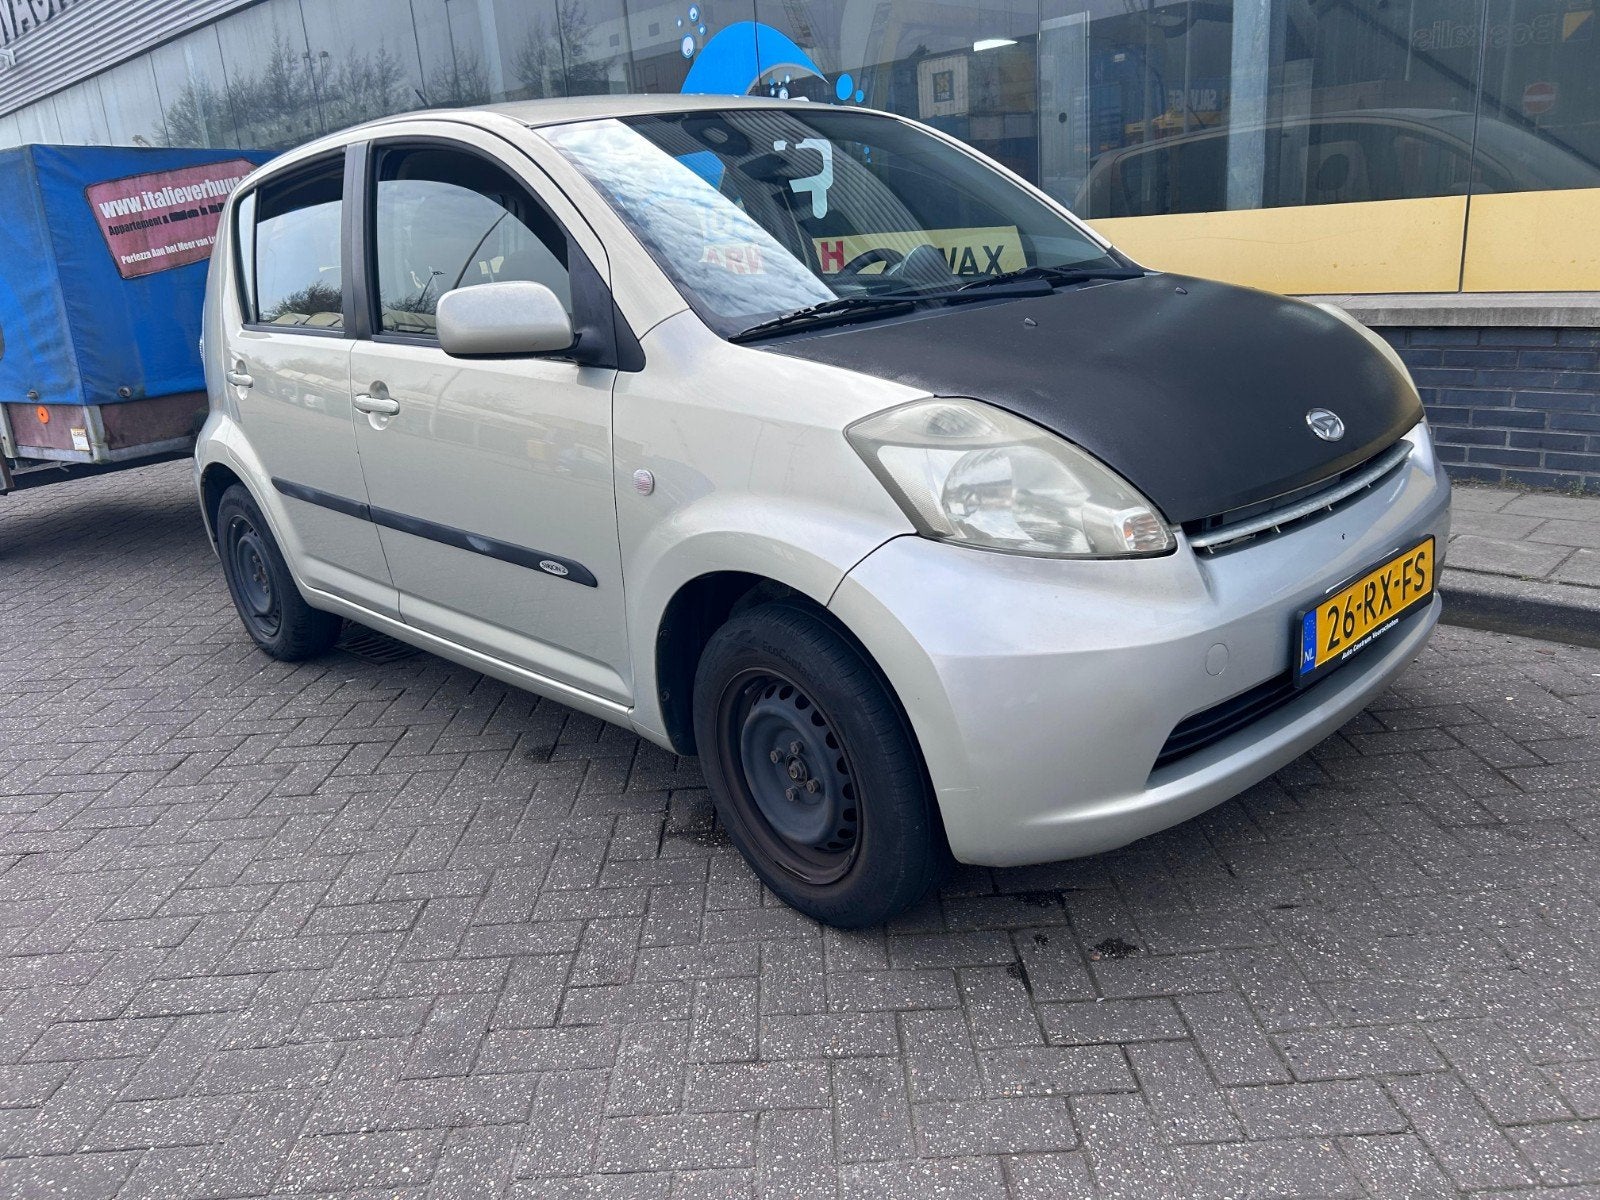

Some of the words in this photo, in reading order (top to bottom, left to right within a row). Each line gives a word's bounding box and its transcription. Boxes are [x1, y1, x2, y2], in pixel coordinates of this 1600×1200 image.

[108, 216, 162, 236] Appartement
[195, 237, 209, 248] van
[1326, 551, 1425, 652] 26-RX-FS
[1303, 647, 1315, 663] NL
[1341, 648, 1353, 660] Auto
[1352, 635, 1372, 652] Centrum
